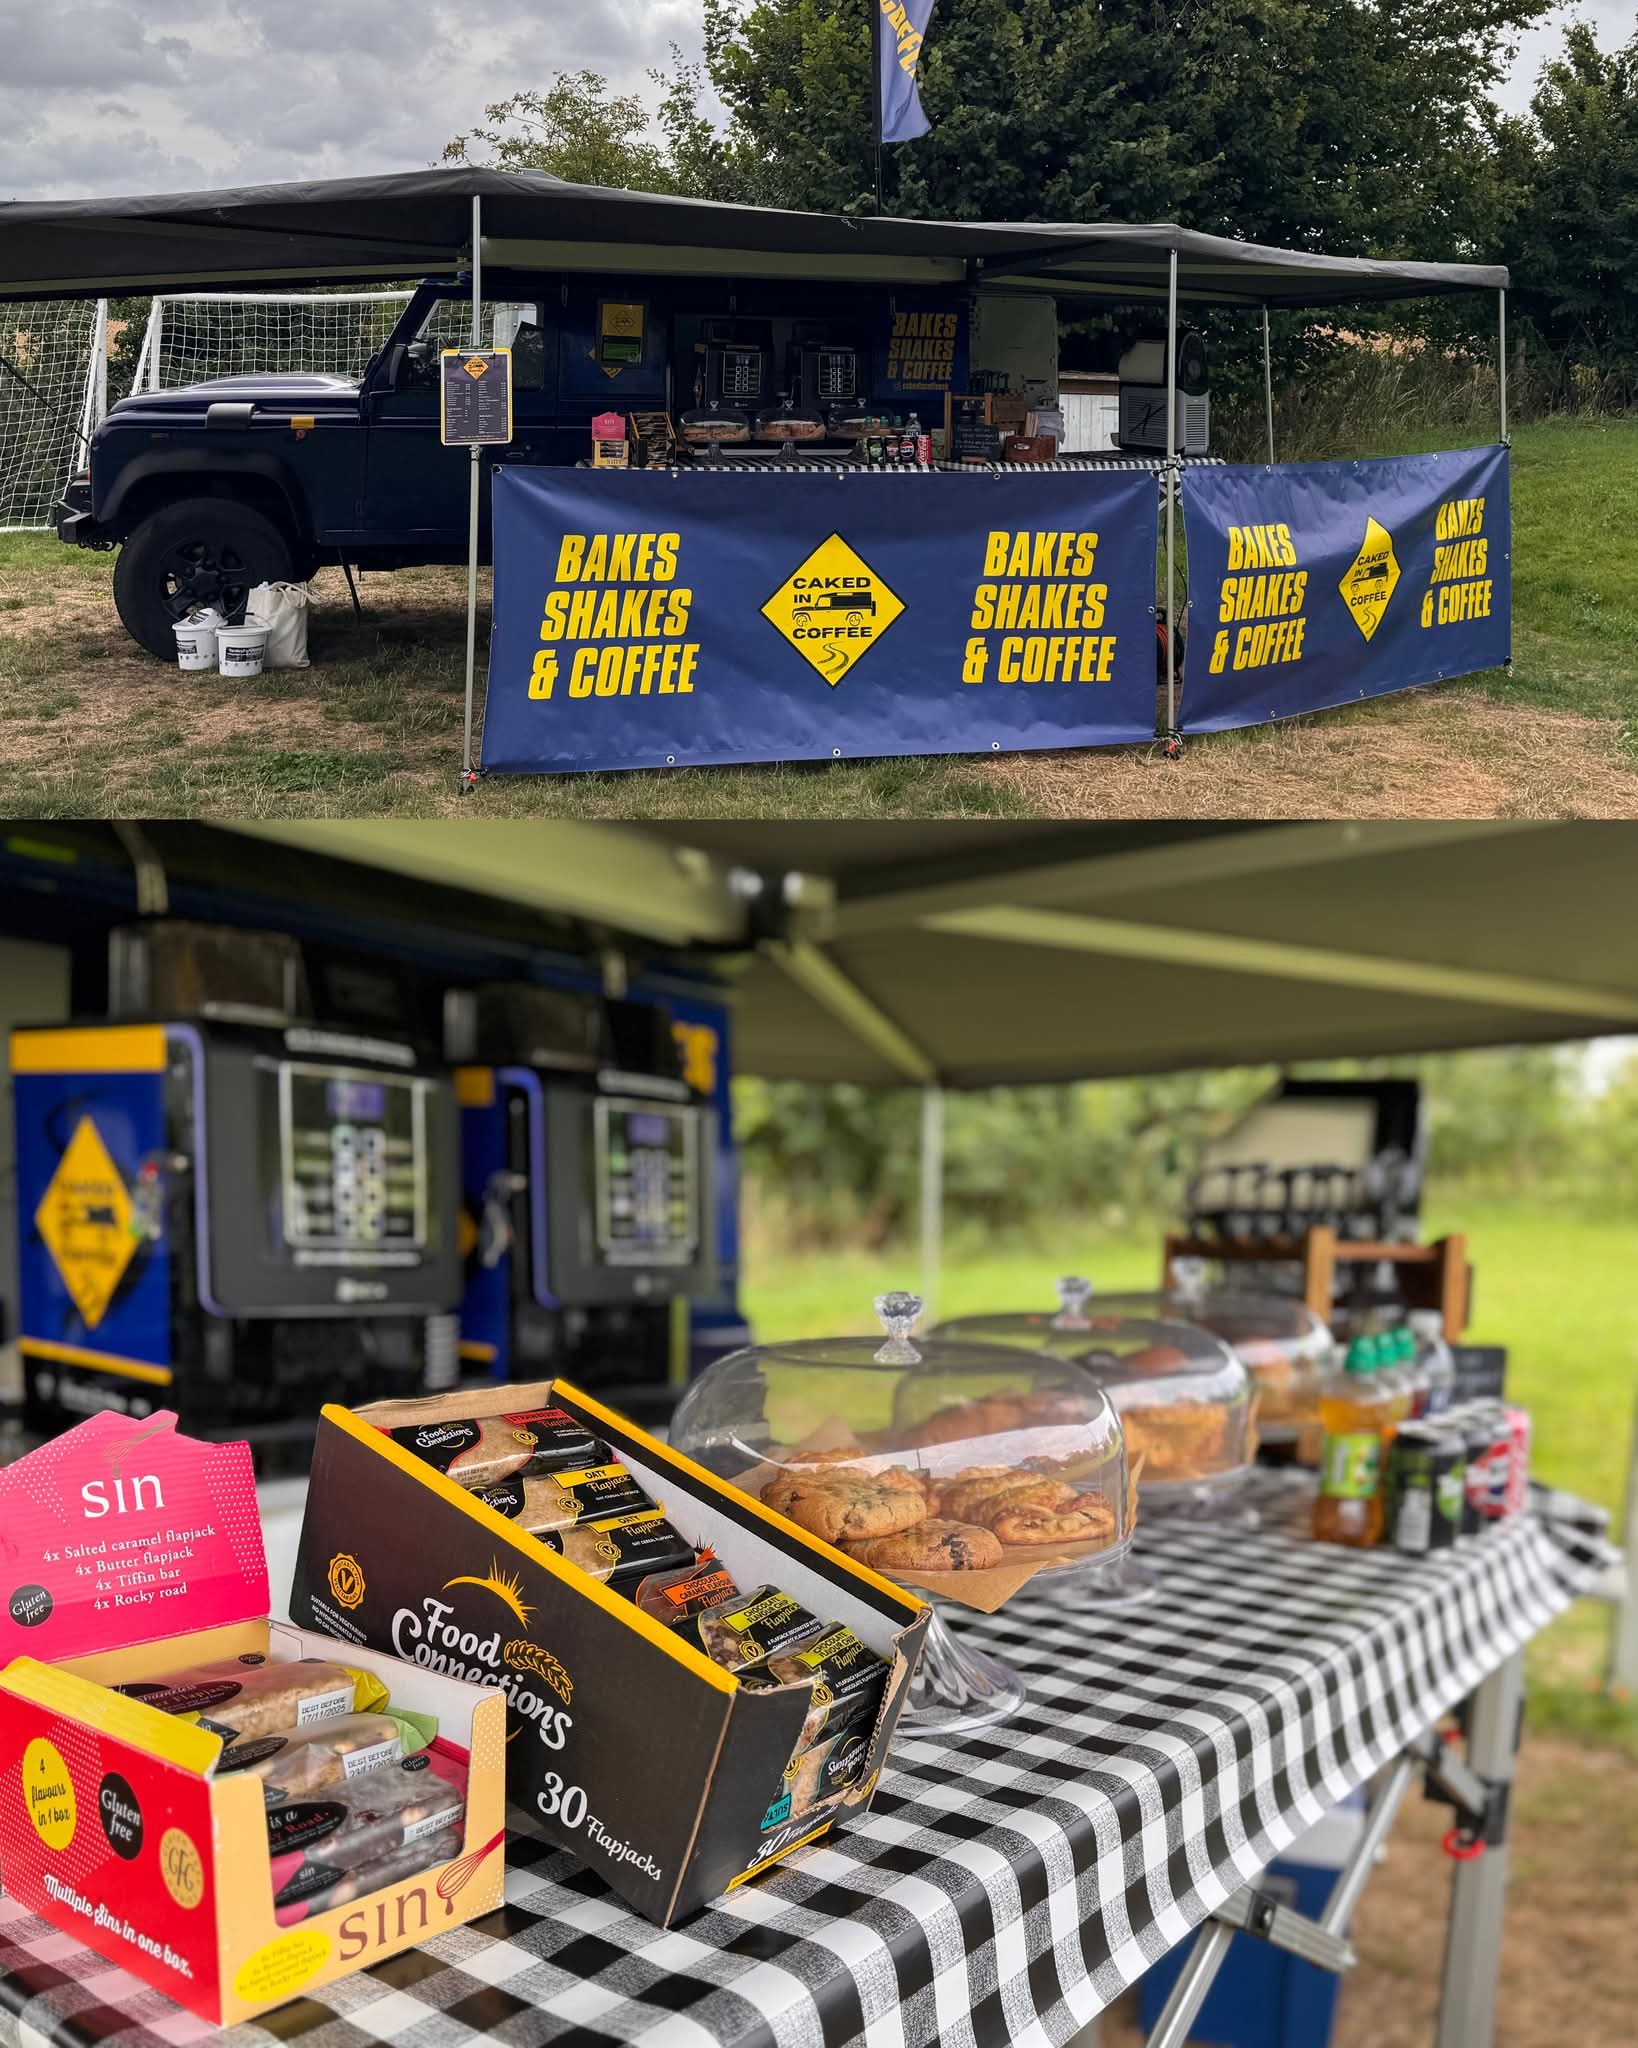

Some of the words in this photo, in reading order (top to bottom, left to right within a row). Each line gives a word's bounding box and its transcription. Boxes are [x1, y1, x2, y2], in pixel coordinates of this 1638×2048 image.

[892, 312, 958, 338] BAKES
[888, 338, 954, 360] SHAKES
[887, 361, 898, 379] &
[903, 361, 953, 380] COFFEE
[1435, 497, 1485, 541] BAKES
[554, 533, 681, 583] BAKES
[983, 531, 1099, 577] BAKES
[1227, 523, 1297, 571] BAKES
[1358, 551, 1390, 566] CAKED
[1354, 568, 1363, 577] IN
[1430, 538, 1488, 585] SHAKES
[792, 577, 871, 590] CAKED
[793, 593, 812, 604] IN
[971, 583, 1108, 630] SHAKES
[1219, 571, 1308, 623] SHAKES
[1350, 591, 1387, 607] COFFEE
[1420, 589, 1434, 629] &
[1438, 579, 1493, 625] COFFEE
[539, 588, 693, 641] SHAKES
[792, 626, 872, 640] COFFEE
[1208, 629, 1230, 674] &
[1232, 617, 1307, 672] COFFEE
[528, 649, 559, 700] &
[568, 643, 700, 699] COFFEE
[962, 637, 989, 684] &
[998, 636, 1117, 683] COFFEE
[416, 1428, 473, 1448] Connections
[418, 1427, 445, 1440] Food
[585, 1469, 607, 1480] OATY
[586, 1474, 631, 1493] Flapjack
[81, 1473, 165, 1518] sin
[618, 1514, 641, 1524] OATY
[621, 1519, 665, 1538] Flapjack
[43, 1549, 60, 1562] 4x
[64, 1541, 107, 1559] Salted
[111, 1533, 162, 1552] caramel
[166, 1523, 216, 1544] flapjack
[75, 1563, 91, 1576] 4x
[96, 1557, 138, 1573] Butter
[143, 1545, 194, 1567] flapjack
[95, 1578, 112, 1591] 4x
[116, 1571, 156, 1588] Tiffin
[159, 1567, 181, 1581] bar
[341, 1569, 354, 1592] V
[683, 1575, 720, 1591] CHOCOLATE
[12, 1590, 47, 1617] Gluten
[93, 1598, 110, 1611] 4x
[115, 1589, 156, 1607] Rocky
[159, 1581, 188, 1598] road
[679, 1586, 706, 1600] CARAMEL
[25, 1604, 45, 1625] free
[743, 1597, 780, 1618] CHOCOLATE
[761, 1602, 800, 1631] Flapjack
[423, 1597, 501, 1668] Food
[814, 1631, 849, 1654] CHOCOLATE
[831, 1640, 867, 1671] Flapjack
[302, 1704, 320, 1715] BEST
[320, 1696, 346, 1709] BEFORE
[302, 1704, 346, 1726] 17/11/2025
[39, 1758, 46, 1775] 4
[347, 1757, 367, 1769] BEST
[368, 1748, 393, 1763] BEFORE
[31, 1782, 67, 1809] flavours
[101, 1789, 141, 1827] Gluten
[537, 1771, 588, 1829] 30
[37, 1809, 48, 1827] in
[53, 1807, 71, 1822] box
[109, 1814, 134, 1843] free
[586, 1814, 663, 1882] Flapjacks
[747, 1827, 791, 1869] 30
[299, 1866, 316, 1880] sin
[43, 1873, 94, 1918] Multiple
[94, 1903, 122, 1935] Sins
[122, 1921, 137, 1944] in
[137, 1933, 163, 1960] one
[339, 1887, 429, 1962] sin
